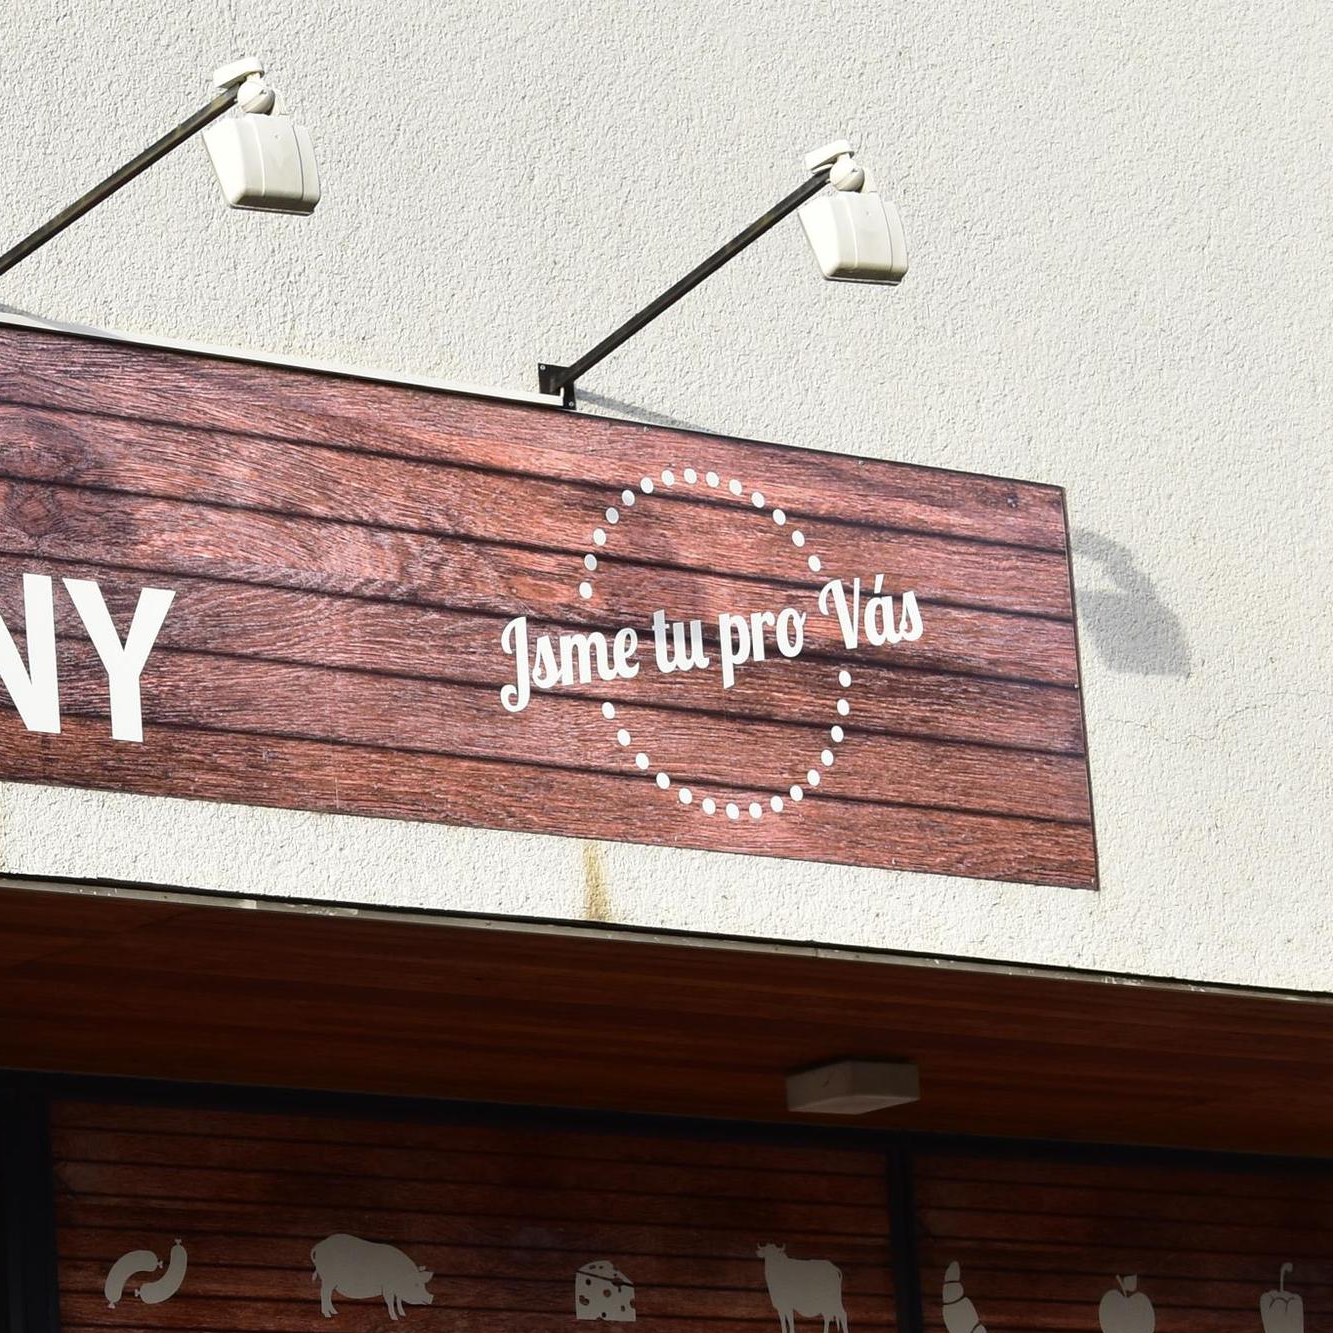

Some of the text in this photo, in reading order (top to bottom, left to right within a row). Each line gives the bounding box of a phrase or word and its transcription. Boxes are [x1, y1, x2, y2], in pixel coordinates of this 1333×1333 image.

[500, 573, 924, 713] Jsme tu pro Vás
